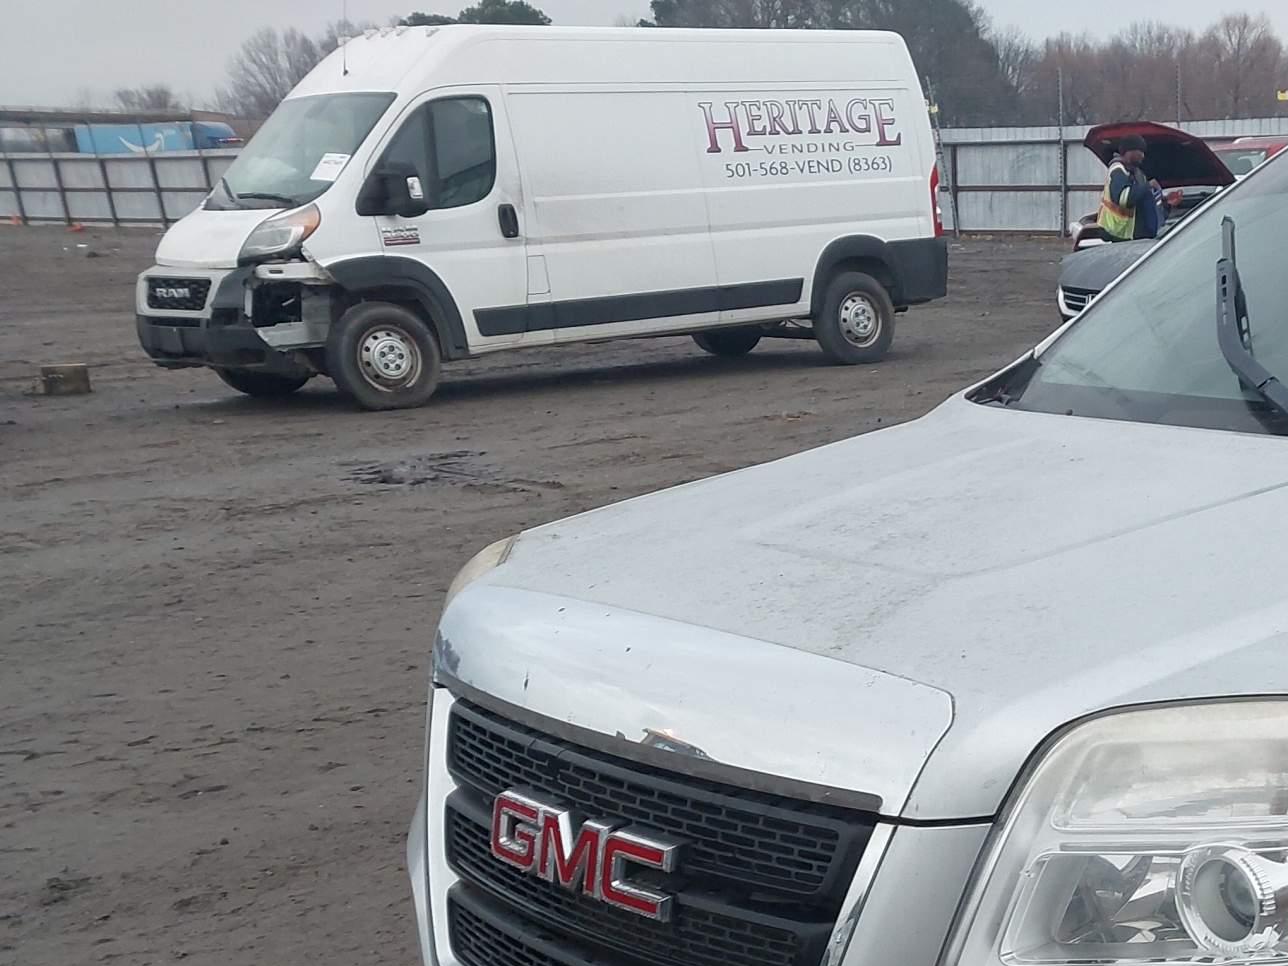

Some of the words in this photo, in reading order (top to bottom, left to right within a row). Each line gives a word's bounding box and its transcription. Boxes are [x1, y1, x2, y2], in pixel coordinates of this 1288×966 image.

[698, 98, 901, 153] HERITAGE
[763, 141, 855, 155] VENDING
[725, 158, 843, 178] 501-568-VEND
[847, 155, 893, 174] (8363)
[155, 287, 191, 298] RAM
[490, 790, 677, 923] GMC
